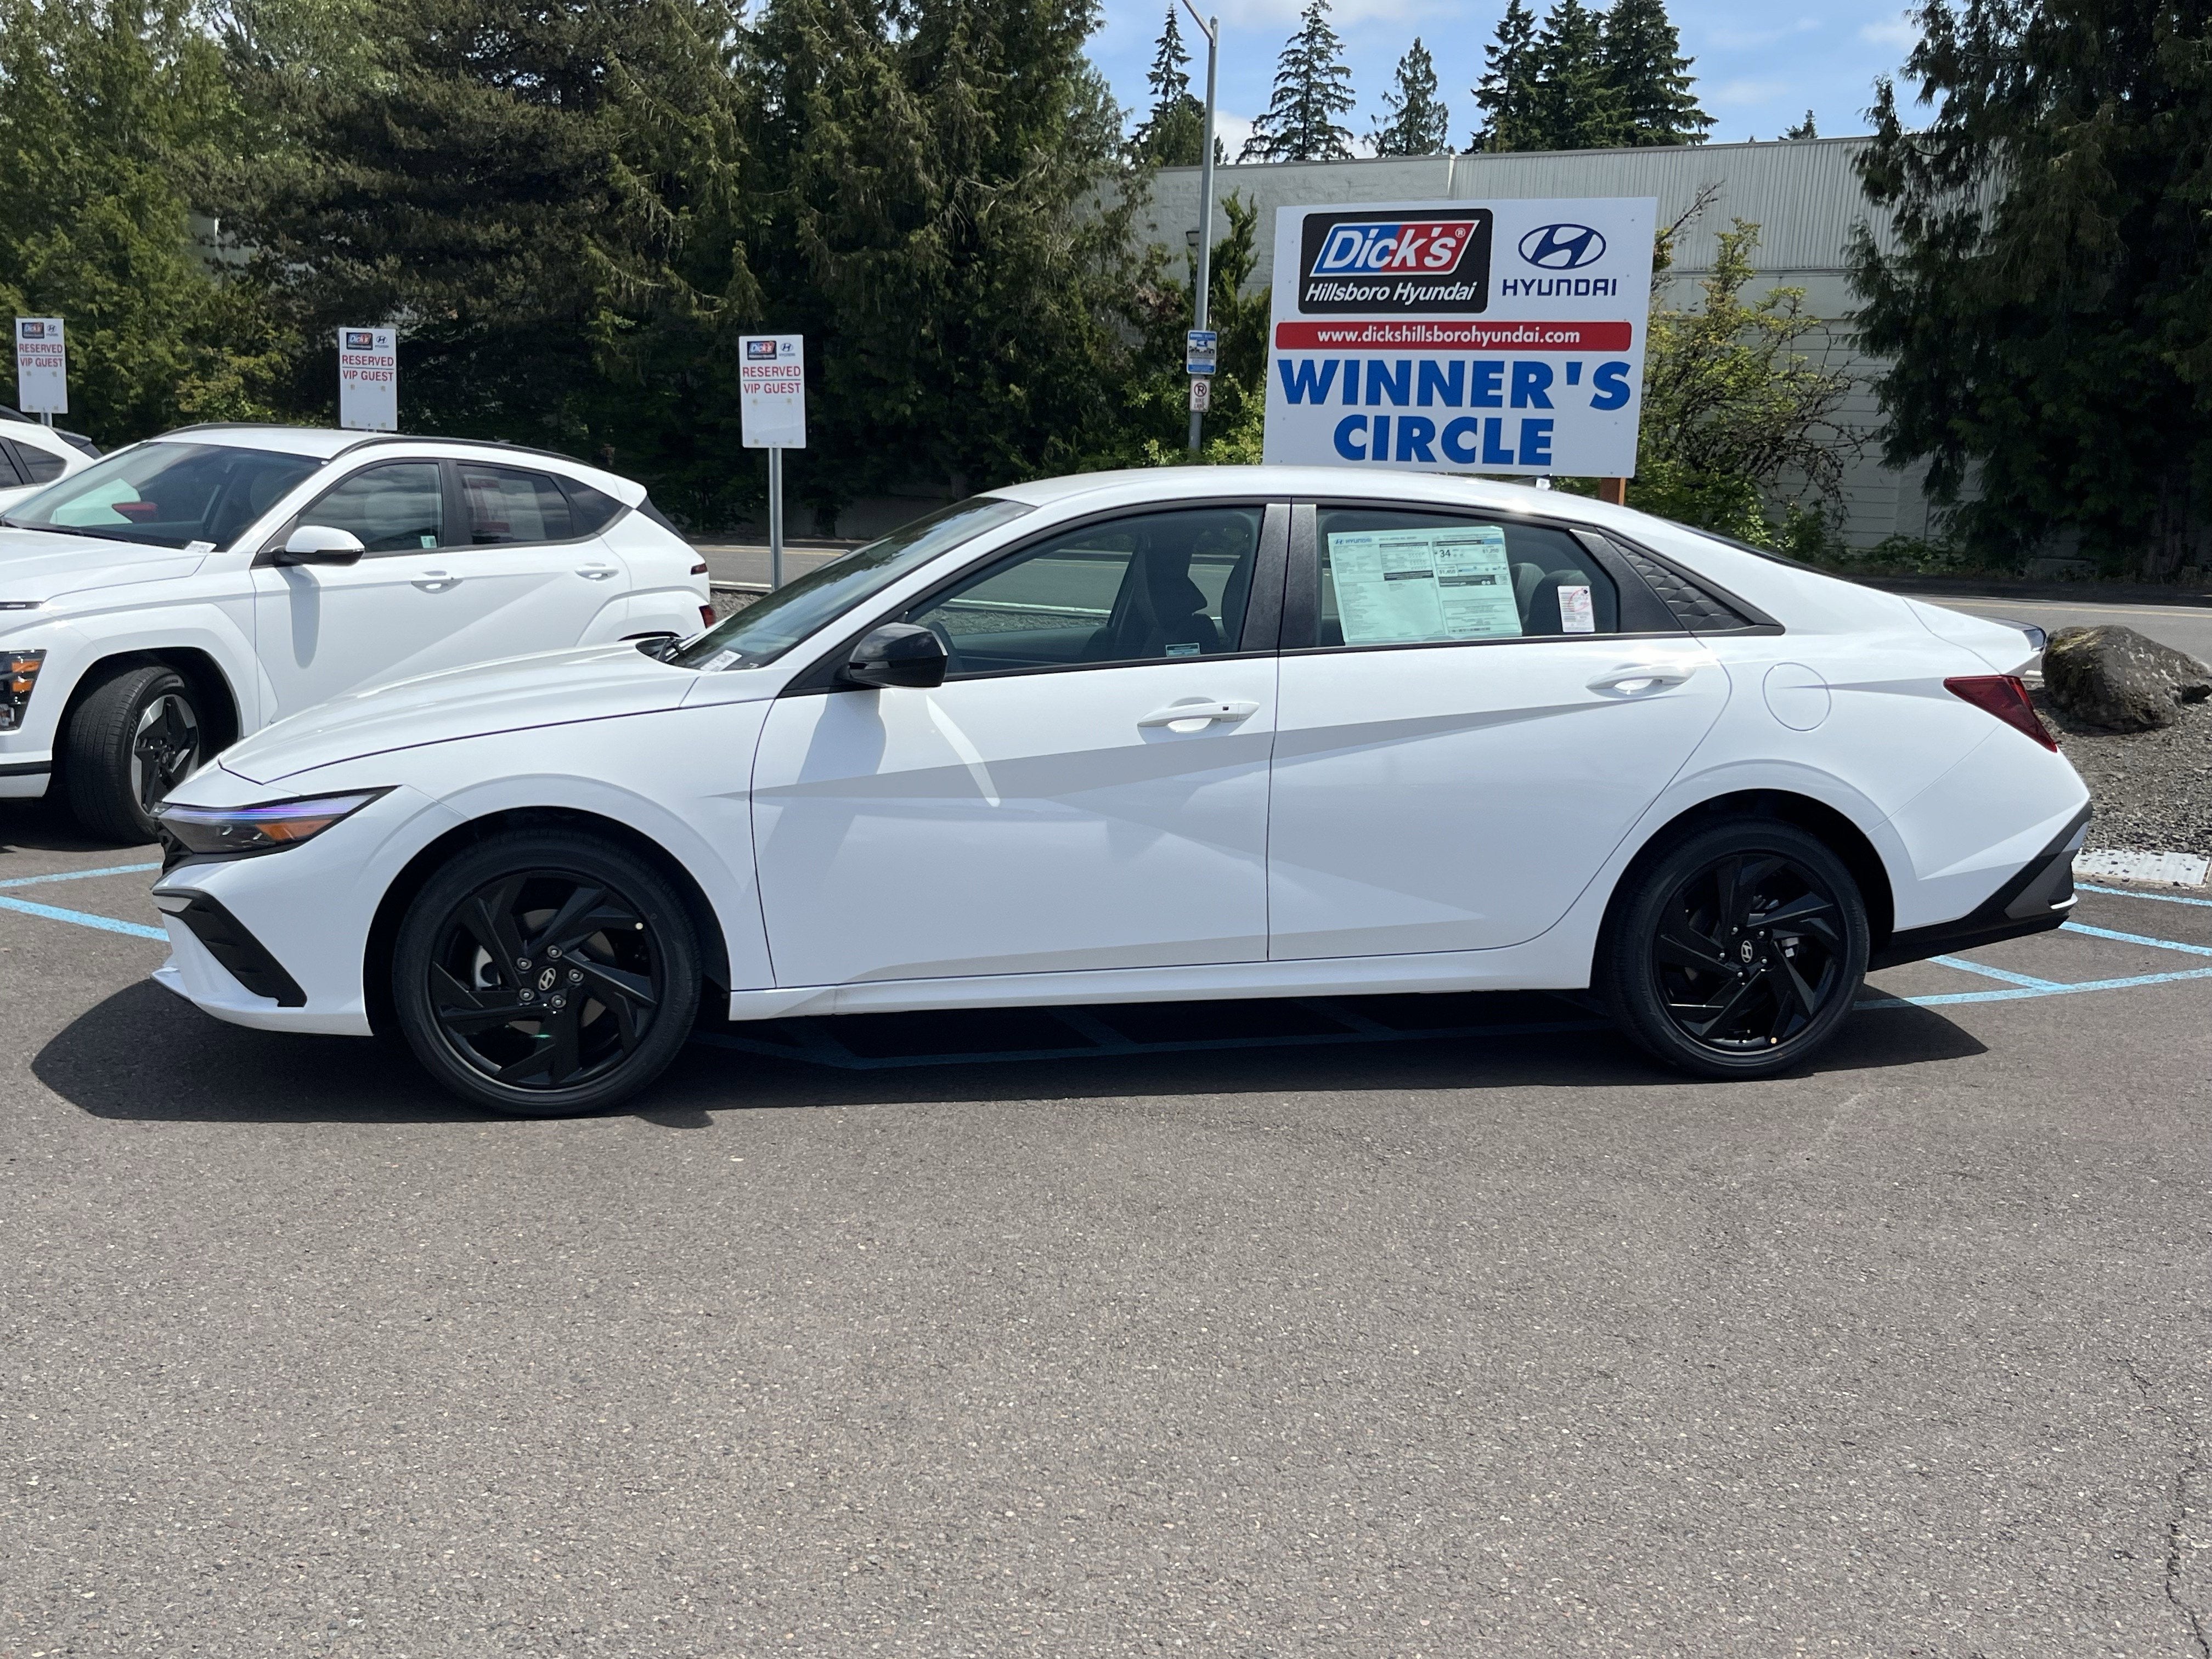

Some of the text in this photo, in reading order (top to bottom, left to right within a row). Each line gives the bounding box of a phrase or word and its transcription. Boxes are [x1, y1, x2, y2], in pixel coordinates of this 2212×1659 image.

[1323, 227, 1456, 268] Dick's
[1305, 281, 1477, 306] Hillsboro Hyundai
[1503, 279, 1617, 296] HYUNDAI
[1317, 326, 1580, 347] www.dickshillsborohyundai.com
[19, 343, 63, 354] RESERVED
[20, 358, 63, 367] VIP GUEST
[342, 354, 394, 366] RESERVED
[343, 370, 394, 381] VIP GUEST
[742, 366, 801, 377] RESERVED
[744, 383, 801, 394] VIP GUEST
[1278, 359, 1632, 411] WINNER'S
[1333, 415, 1554, 466] CIRCLE
[1439, 549, 1451, 557] 34
